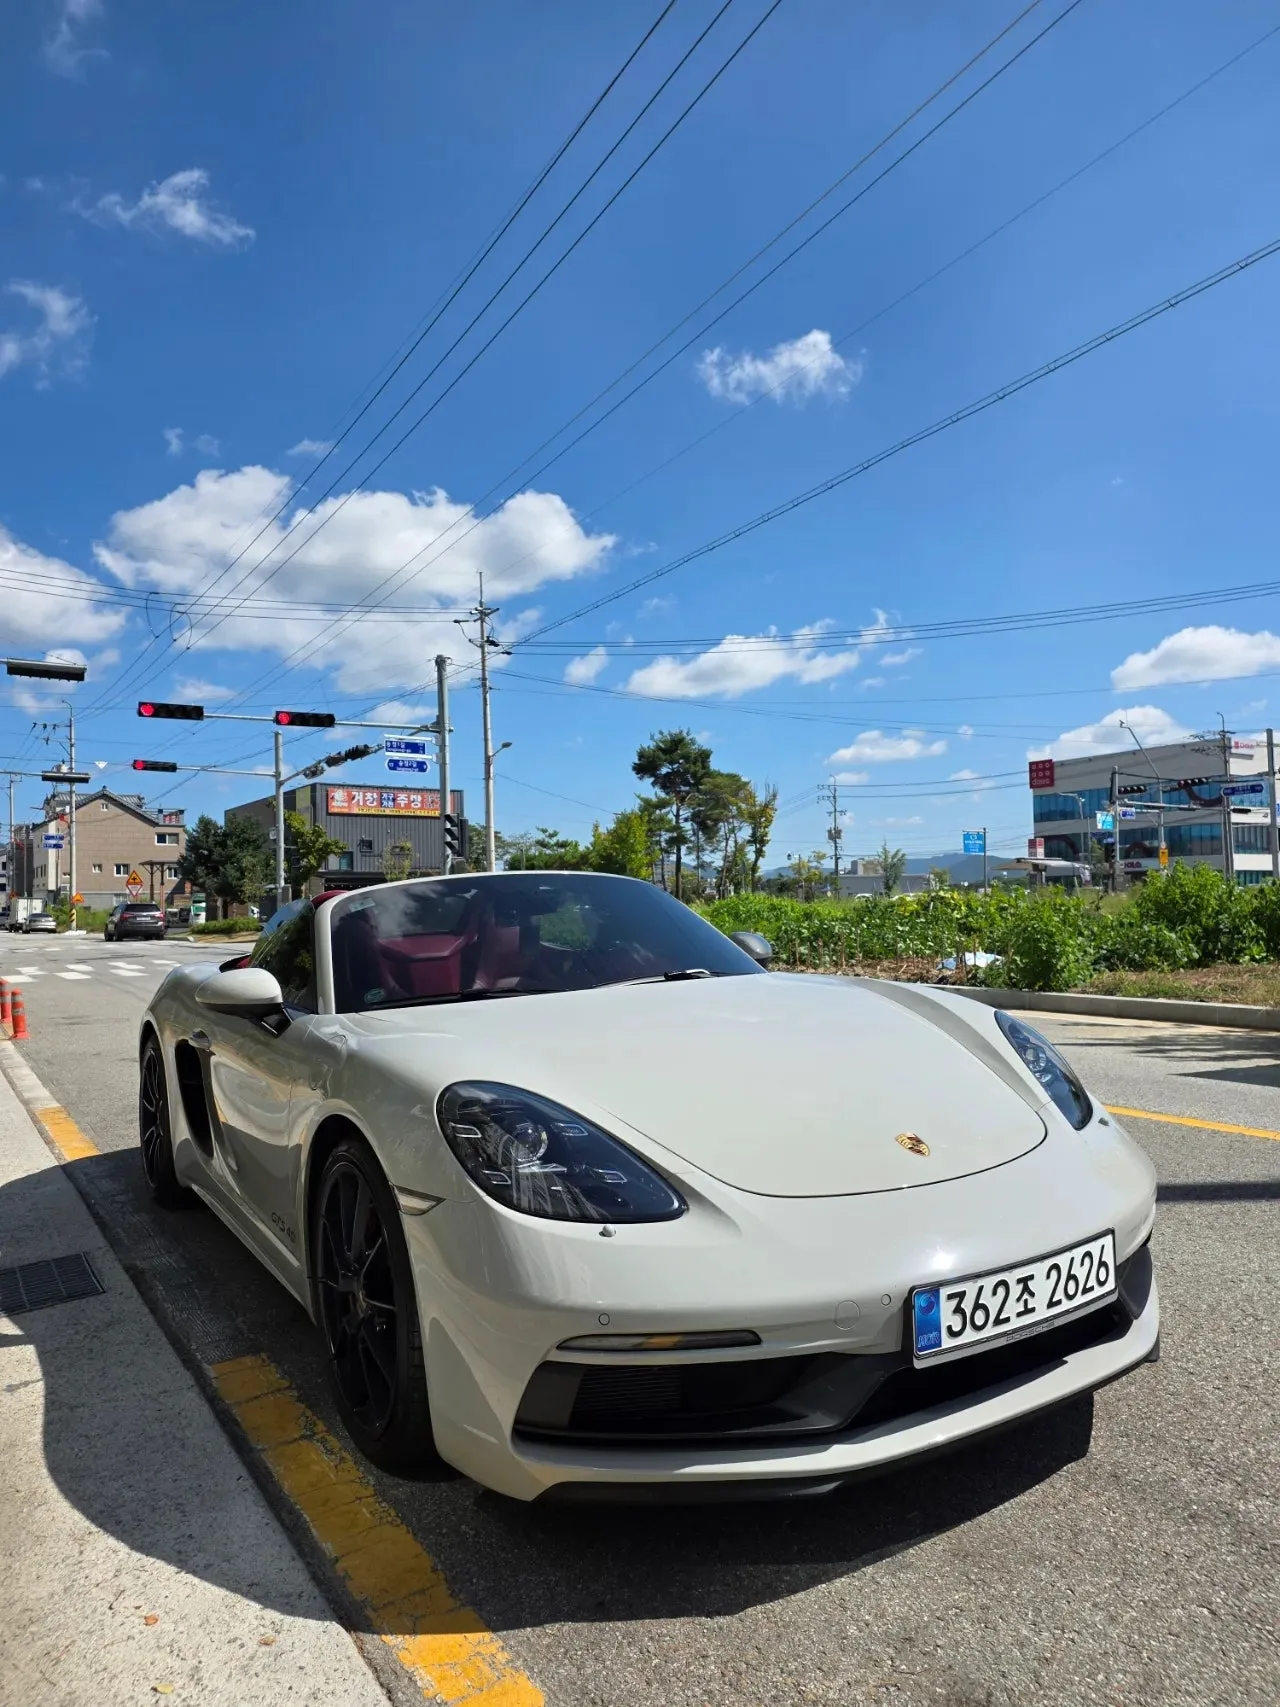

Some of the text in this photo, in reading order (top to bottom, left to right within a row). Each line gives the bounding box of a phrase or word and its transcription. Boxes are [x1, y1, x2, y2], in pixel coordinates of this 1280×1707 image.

[351, 791, 378, 807] 거창
[397, 793, 422, 808] 주방
[271, 1212, 286, 1232] GTS
[945, 1244, 1110, 1339] 362조 2626
[1006, 1320, 1055, 1342] PORSCHE
